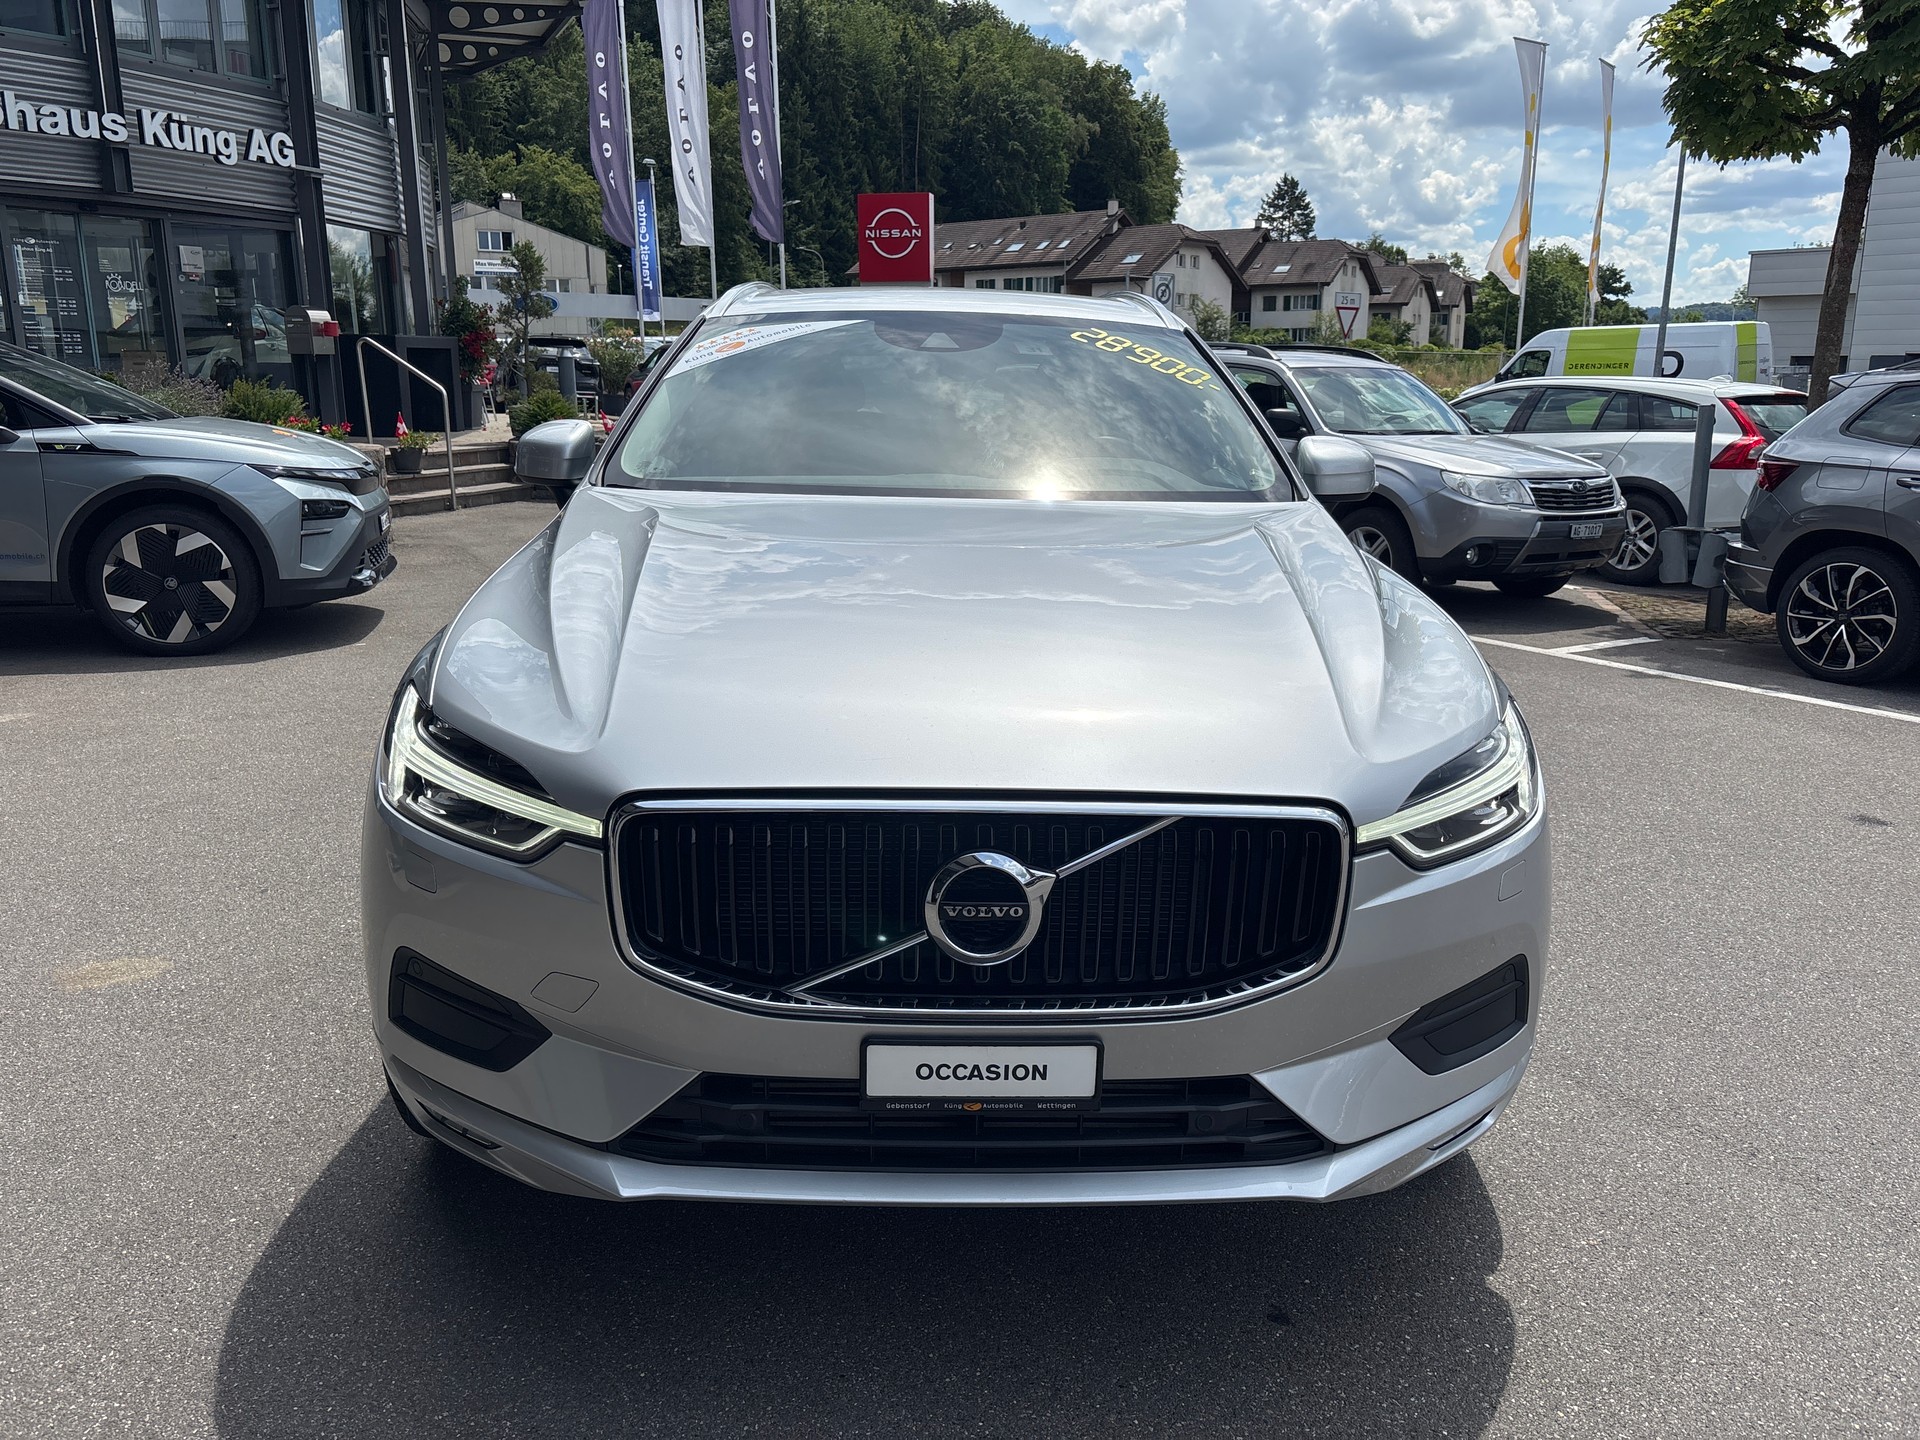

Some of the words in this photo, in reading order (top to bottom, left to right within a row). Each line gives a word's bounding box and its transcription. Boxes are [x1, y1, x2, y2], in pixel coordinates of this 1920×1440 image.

[0, 90, 129, 142] haus
[140, 108, 239, 166] Küng
[247, 128, 297, 168] AG
[865, 228, 922, 238] NISSAN
[1341, 295, 1349, 305] 25
[684, 351, 714, 364] Küng
[747, 323, 812, 343] Automobile
[1568, 362, 1629, 371] DERENDINGER
[943, 906, 1024, 917] VOLVO
[915, 1063, 1048, 1081] OCCASION
[944, 1102, 963, 1110] Küng
[1037, 1102, 1077, 1110] Wettingen
